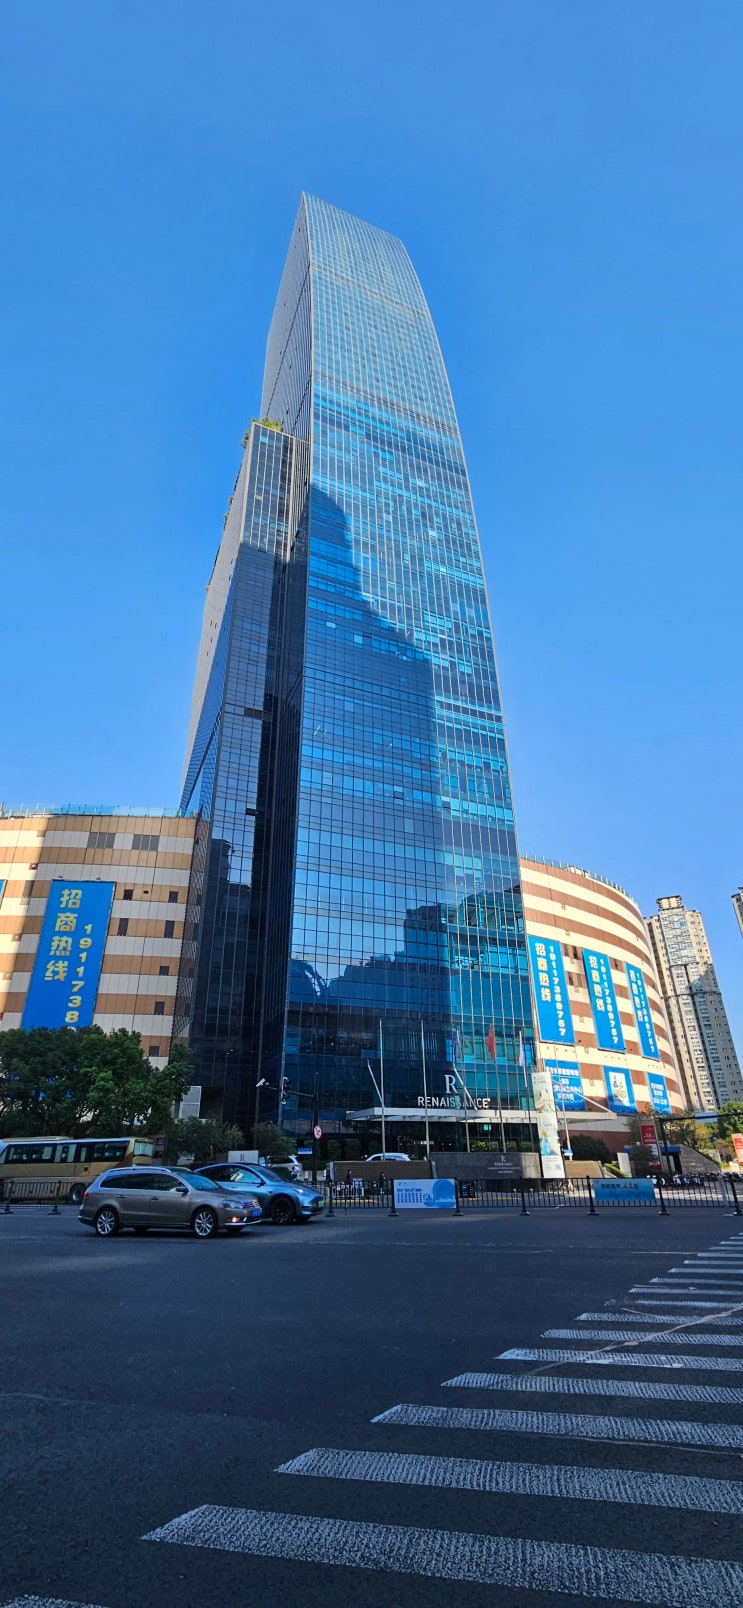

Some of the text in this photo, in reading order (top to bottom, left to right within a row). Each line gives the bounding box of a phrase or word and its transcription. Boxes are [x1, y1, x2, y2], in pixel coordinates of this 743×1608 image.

[44, 888, 83, 982] 招商热线
[535, 942, 551, 1003] 招商热线
[417, 1096, 490, 1109] RENAISSANCE
[443, 1074, 459, 1094] R
